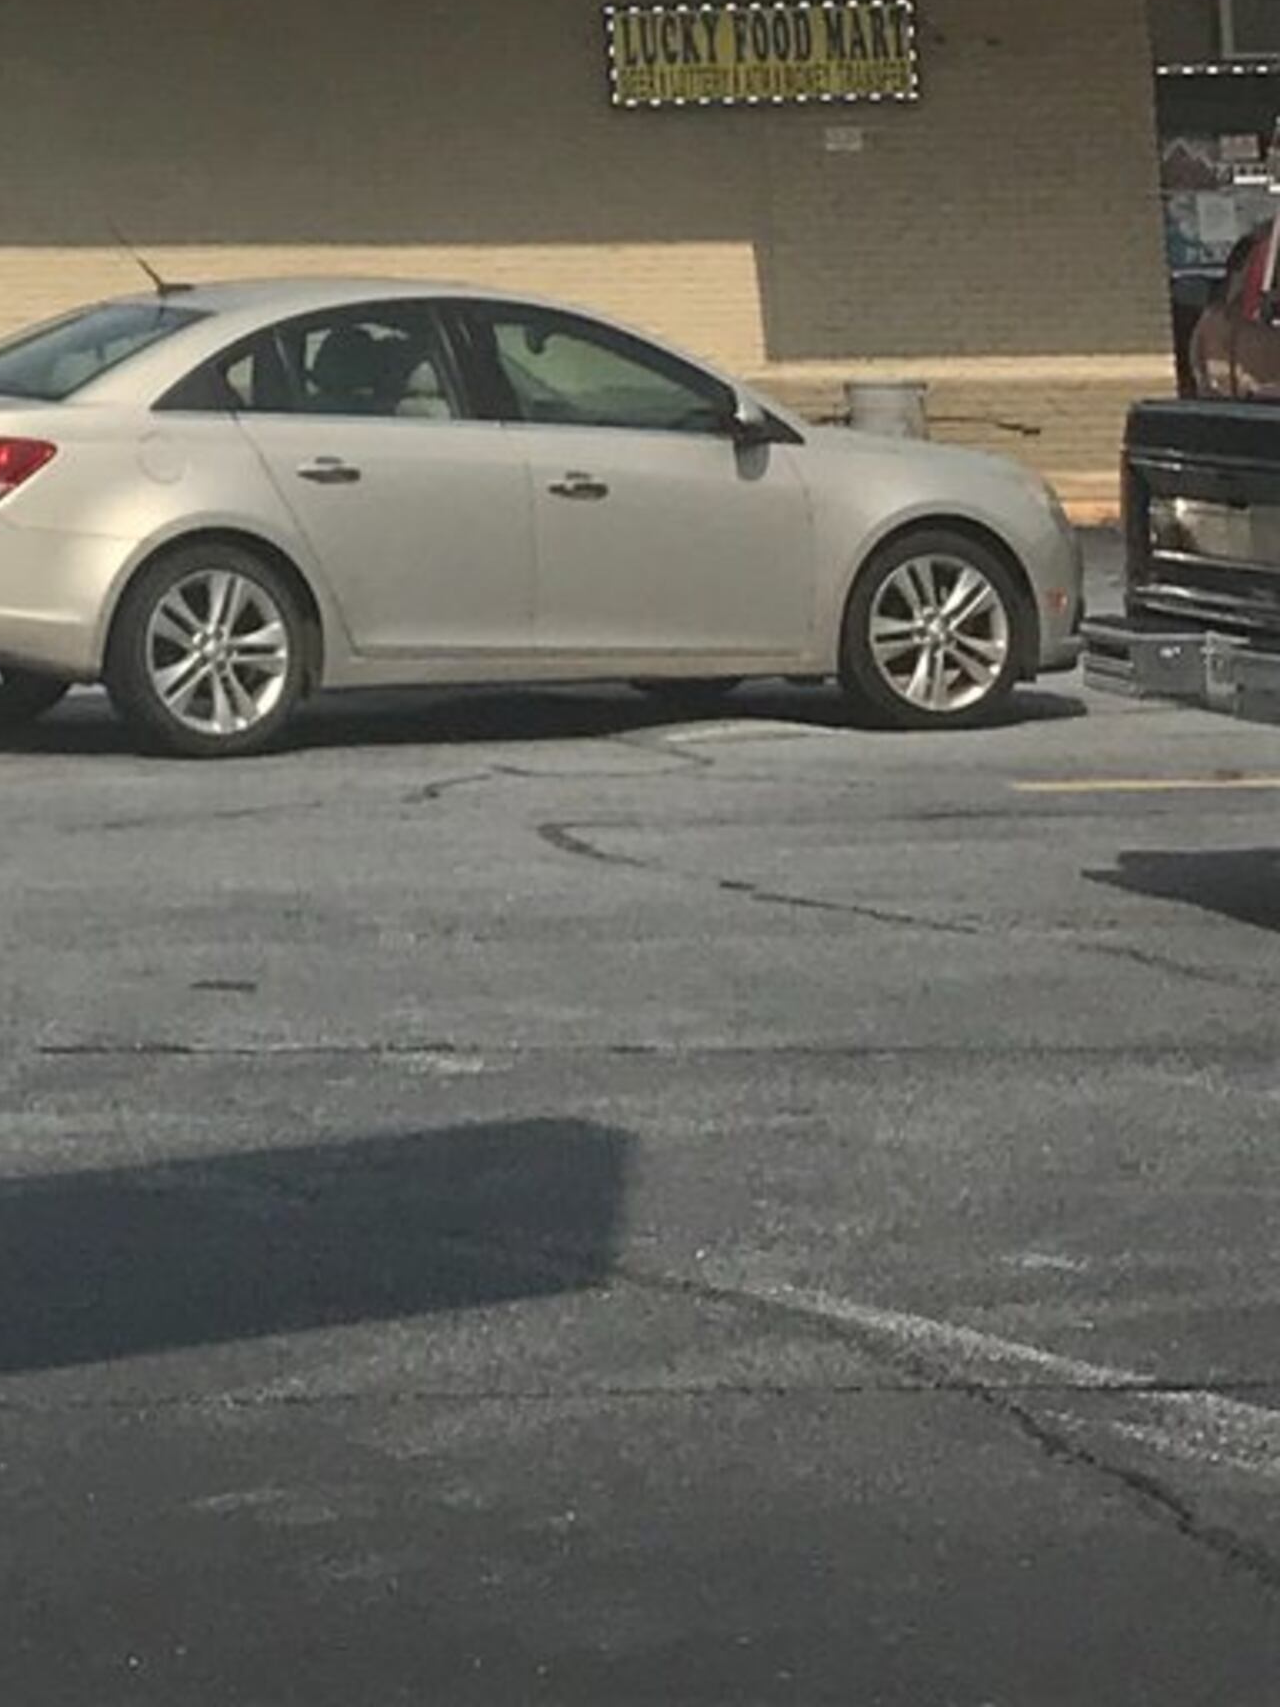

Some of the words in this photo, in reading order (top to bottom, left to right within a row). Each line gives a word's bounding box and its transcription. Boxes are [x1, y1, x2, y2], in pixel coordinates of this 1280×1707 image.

[620, 11, 719, 66] LUCKY
[733, 8, 813, 64] FOOD
[823, 4, 907, 61] MART
